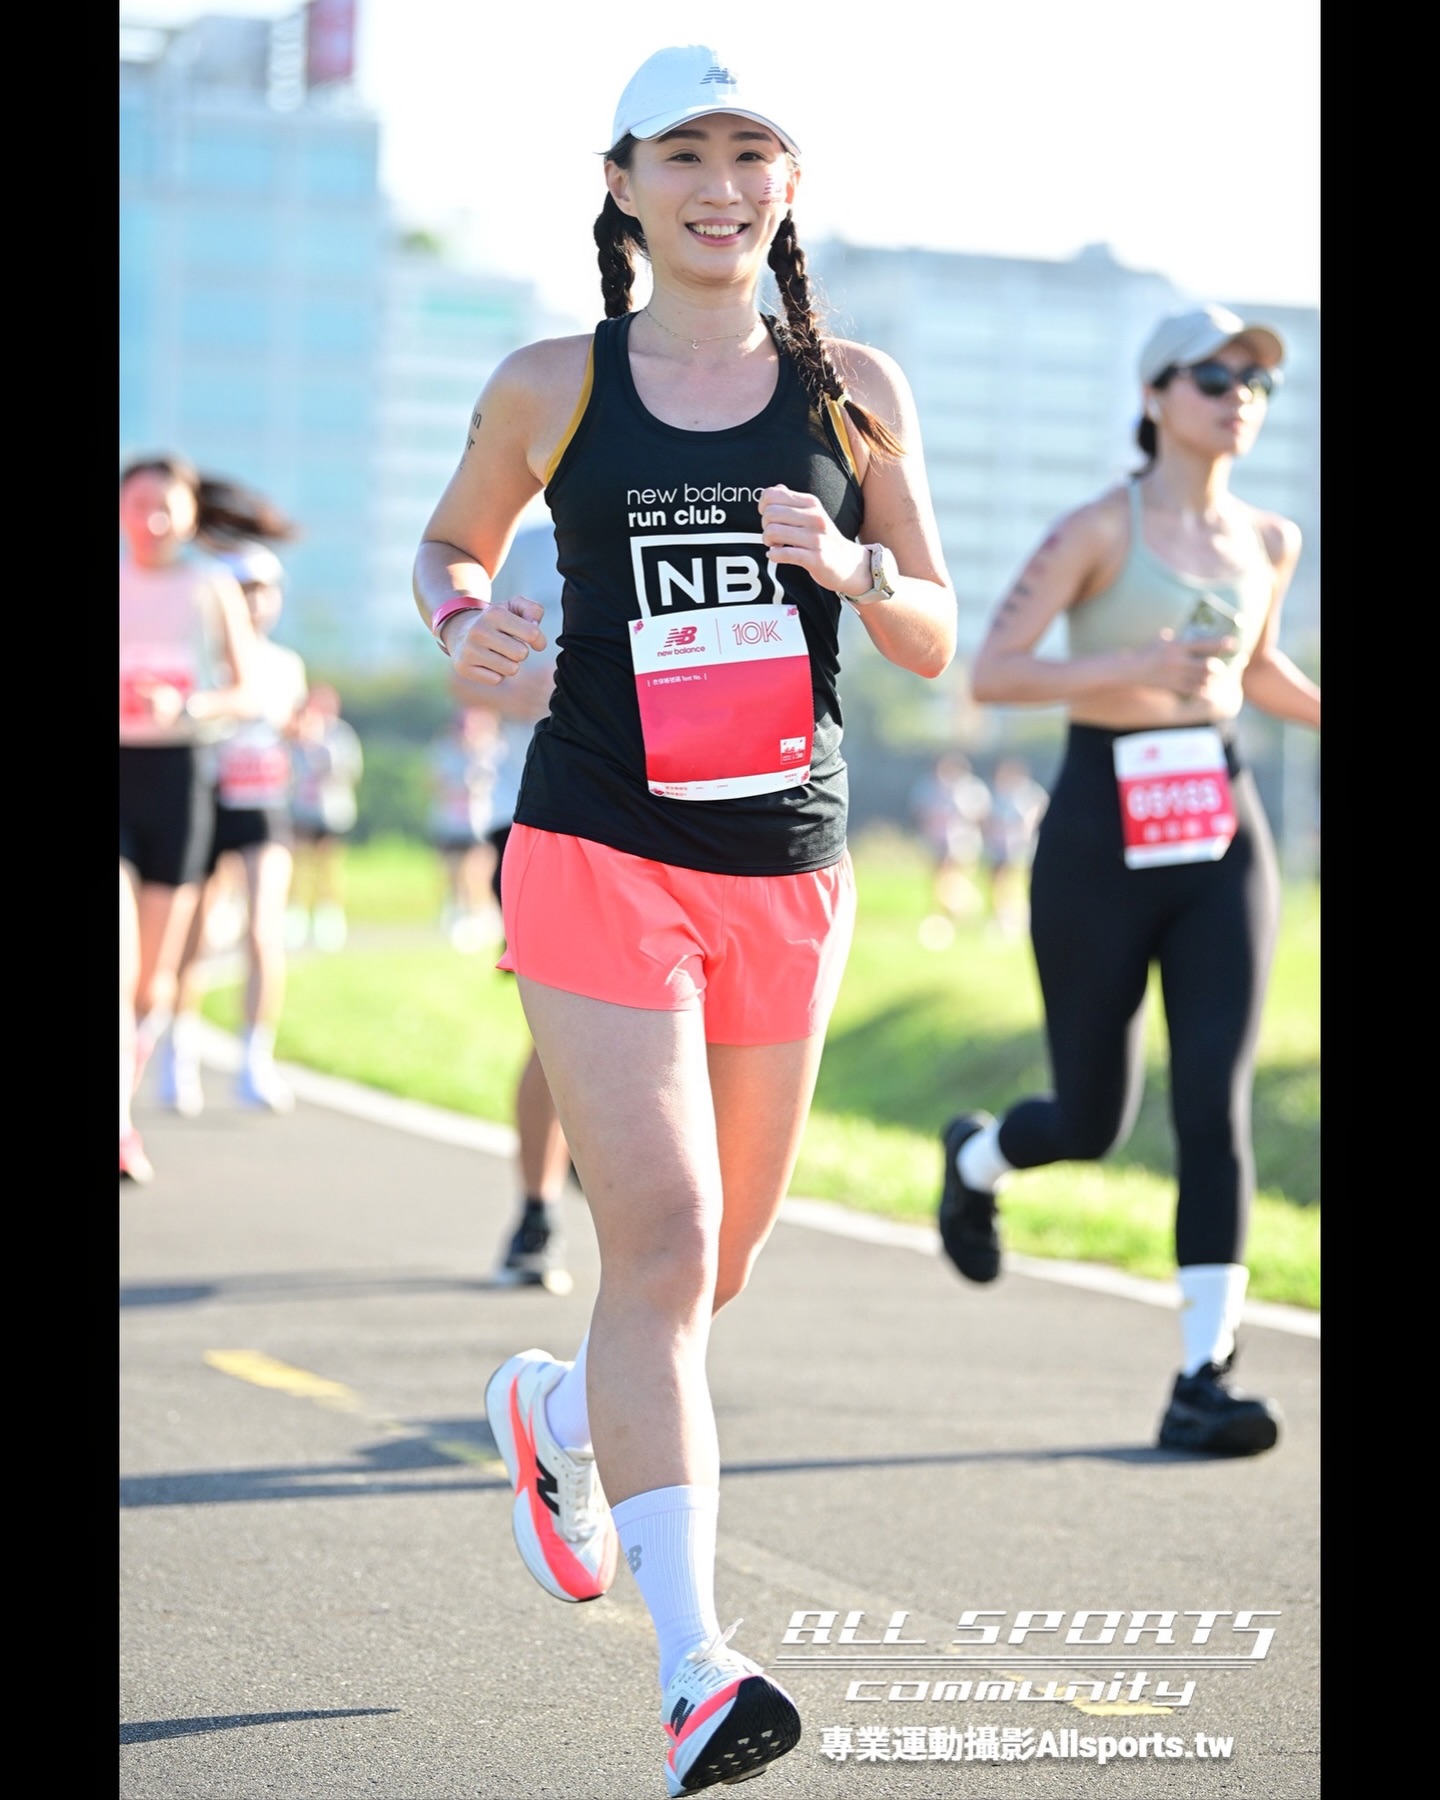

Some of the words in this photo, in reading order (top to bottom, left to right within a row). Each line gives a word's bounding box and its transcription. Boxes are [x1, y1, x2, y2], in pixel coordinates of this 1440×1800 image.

[627, 487, 678, 506] new
[684, 482, 765, 503] balanc
[628, 509, 667, 528] run
[673, 505, 727, 526] club
[657, 555, 763, 607] NB
[731, 620, 783, 646] 10K
[657, 650, 673, 658] new
[674, 645, 706, 656] balance
